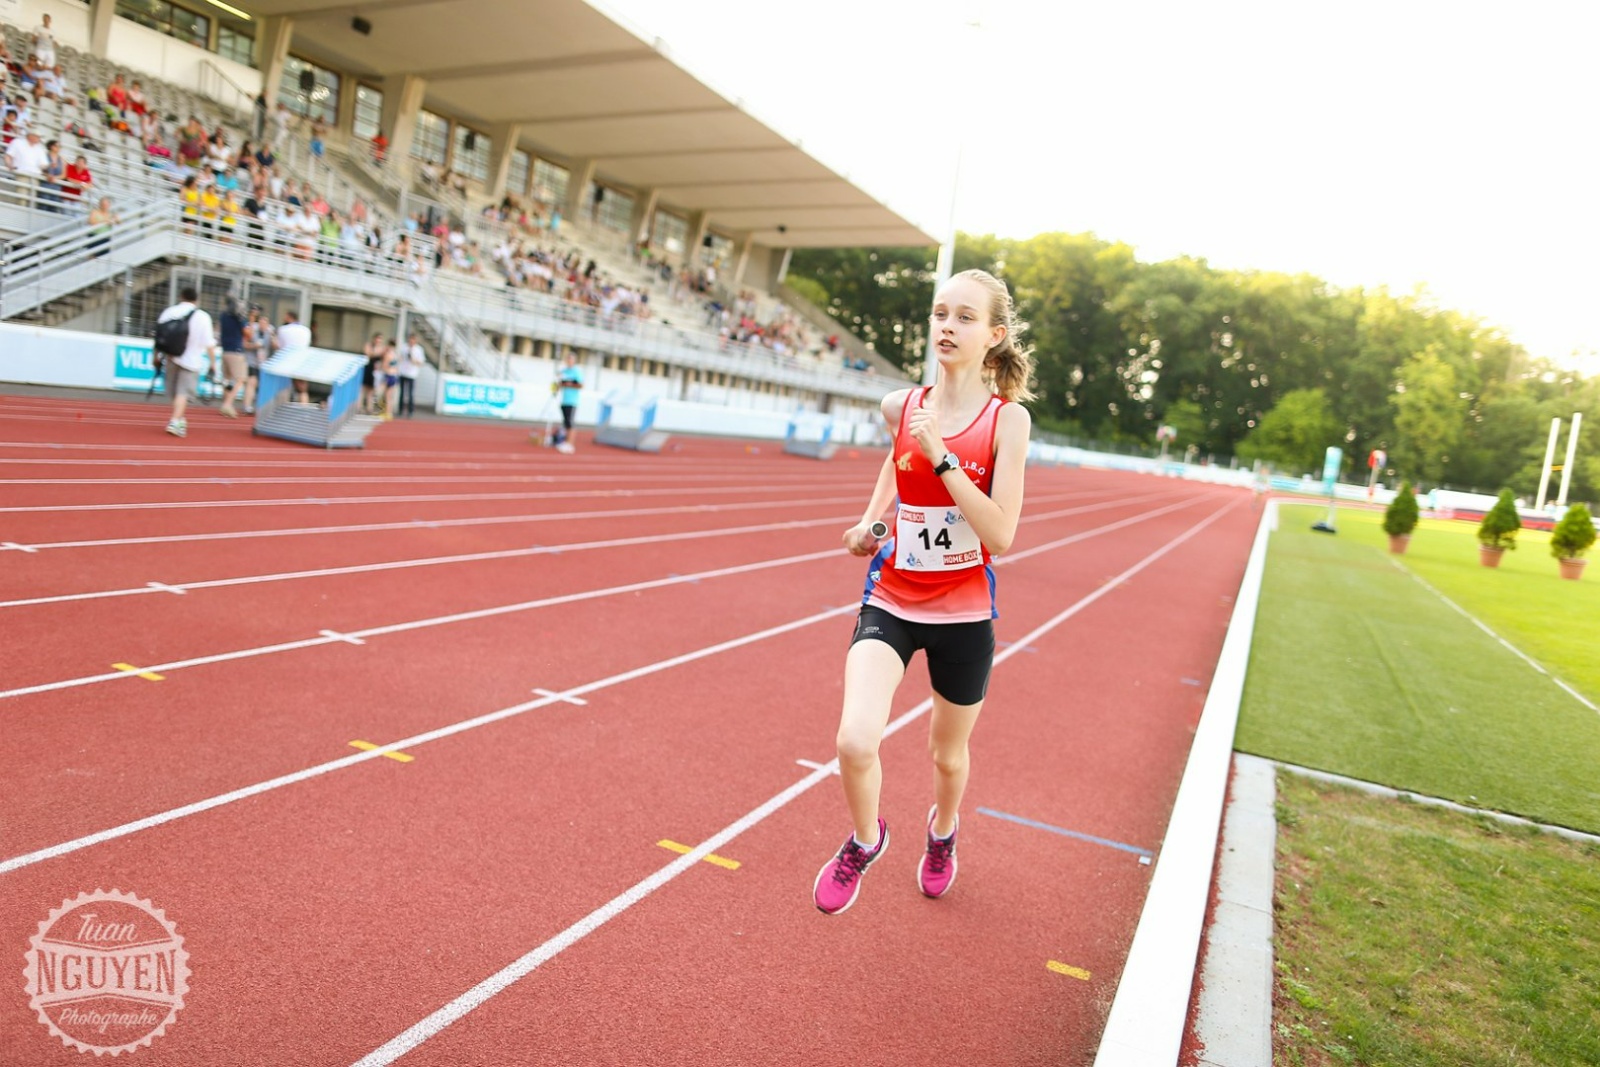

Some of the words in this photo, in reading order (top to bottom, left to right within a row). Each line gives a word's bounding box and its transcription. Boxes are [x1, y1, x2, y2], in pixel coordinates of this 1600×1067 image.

[120, 348, 155, 371] VILL
[918, 527, 952, 550] 14
[943, 554, 963, 564] HOME
[963, 550, 978, 561] BOX
